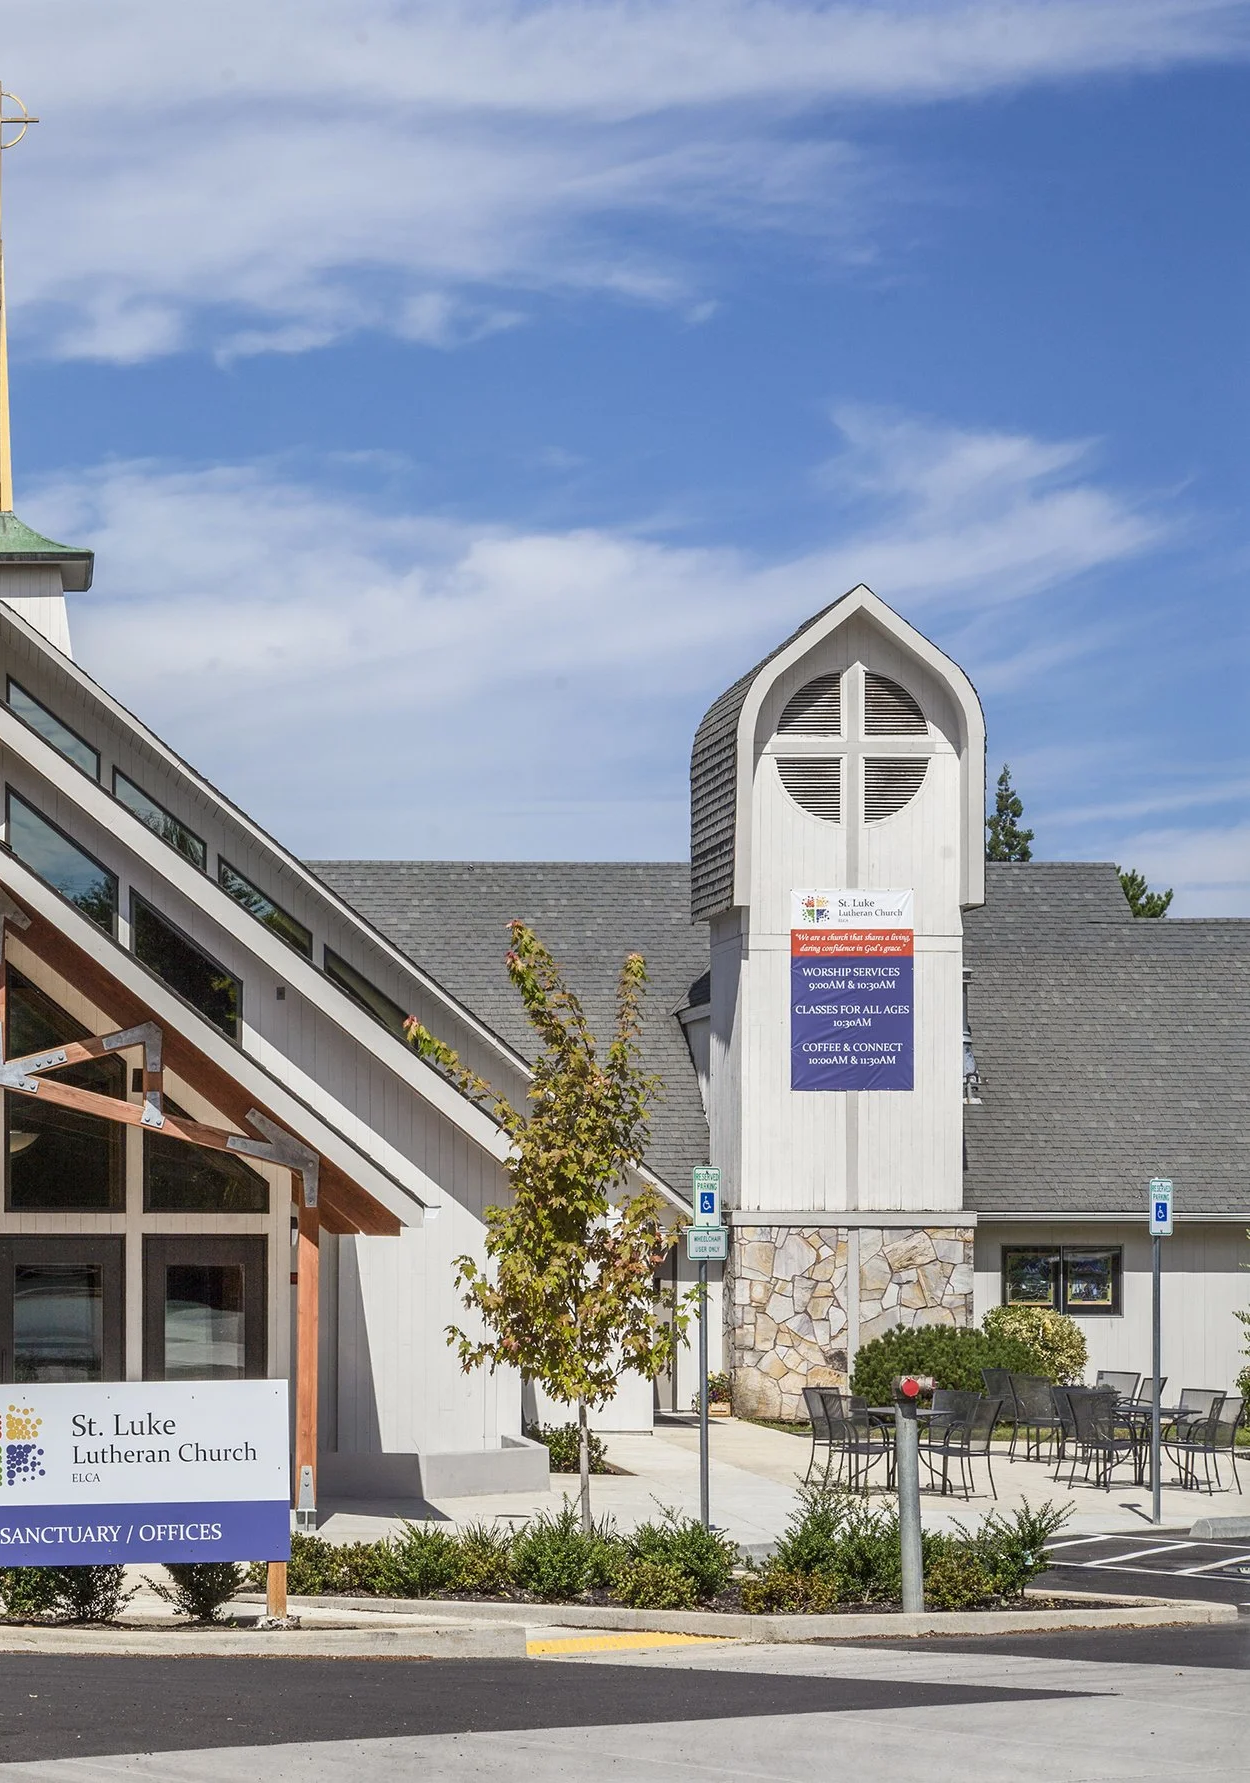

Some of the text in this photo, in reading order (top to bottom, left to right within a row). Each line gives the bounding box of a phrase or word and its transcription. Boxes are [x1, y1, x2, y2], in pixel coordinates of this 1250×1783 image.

[838, 898, 875, 908] St. Luke
[838, 908, 903, 917] Lutheran Church
[827, 933, 848, 941] church
[850, 933, 863, 941] that
[865, 933, 884, 941] shares
[891, 933, 911, 943] living,
[800, 944, 821, 953] daring
[822, 944, 855, 954] confidence
[856, 944, 863, 952] in
[802, 967, 901, 977] WORSHIP SERVICES
[808, 980, 896, 992] 9:00AM & 10:30AM
[795, 1005, 910, 1015] CLASSES FOR ALL AGES
[833, 1018, 872, 1029] 10:30AM
[802, 1042, 904, 1052] COFFEE & CONNECT
[808, 1055, 896, 1067] 10:00AM & 11:30AM
[695, 1172, 719, 1181] RESERVED
[697, 1182, 718, 1191] PARKING
[693, 1235, 721, 1243] WHEELCHAIR
[71, 1411, 177, 1438] St. Luke
[72, 1441, 258, 1465] Lutheran Church
[71, 1473, 101, 1483] ELCA
[0, 1522, 223, 1545] SANCTUARY / OFFICES
